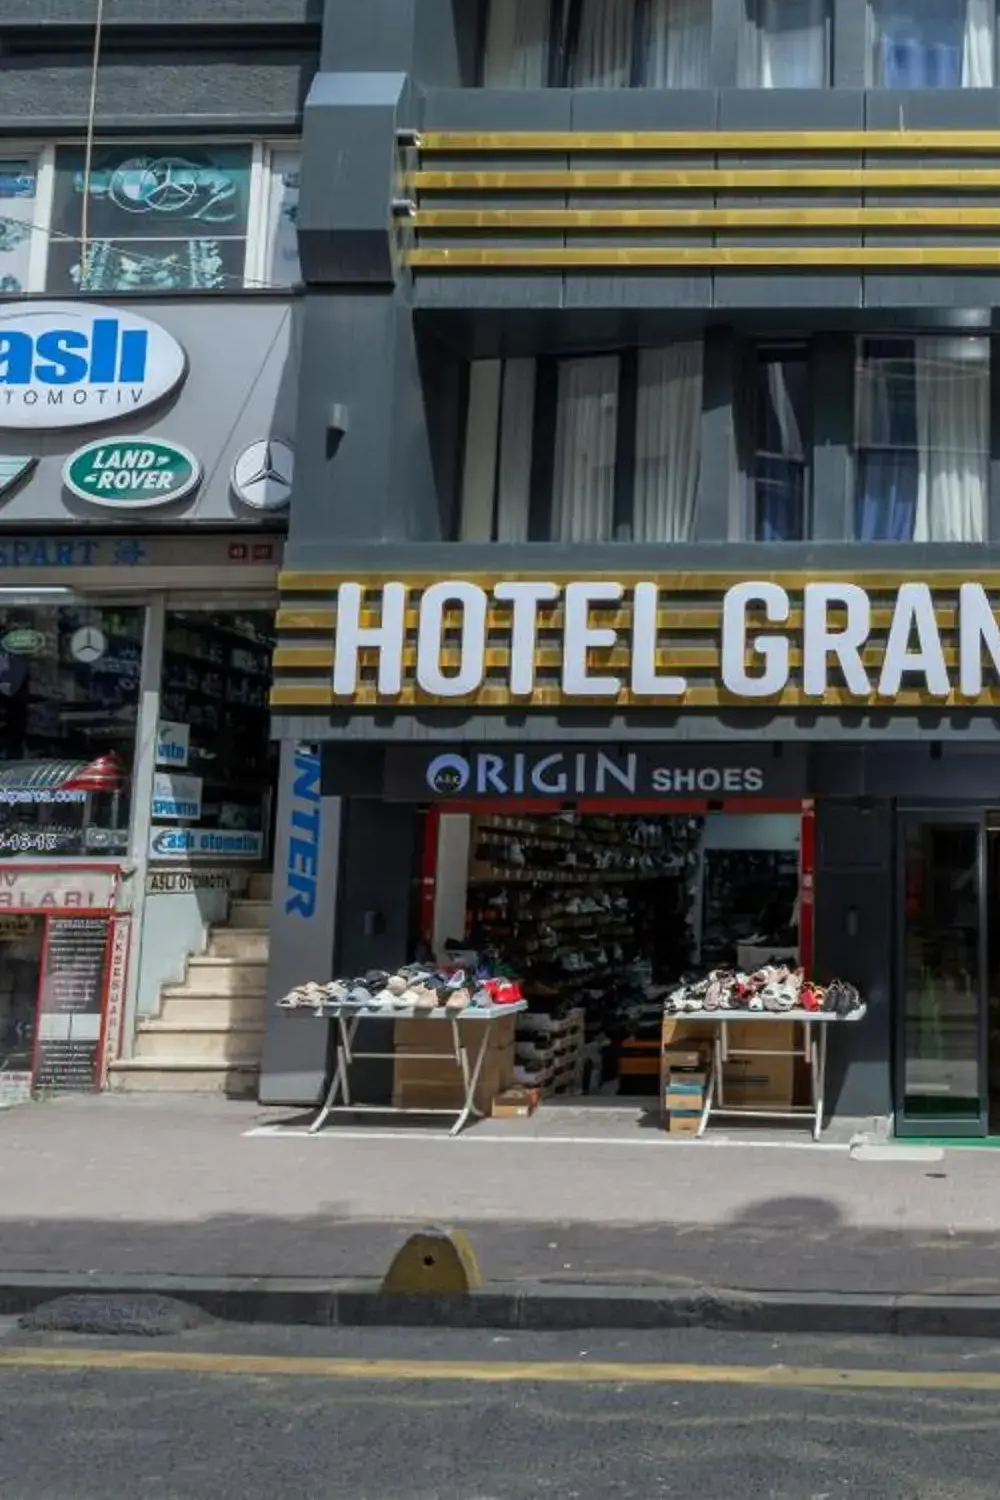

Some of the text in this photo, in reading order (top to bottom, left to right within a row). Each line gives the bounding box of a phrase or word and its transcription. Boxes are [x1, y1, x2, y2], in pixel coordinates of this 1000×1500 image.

[92, 450, 154, 469] LAND
[97, 470, 174, 489] ROVER
[333, 581, 686, 697] HOTEL
[426, 753, 764, 795] ORIGIN SHOES
